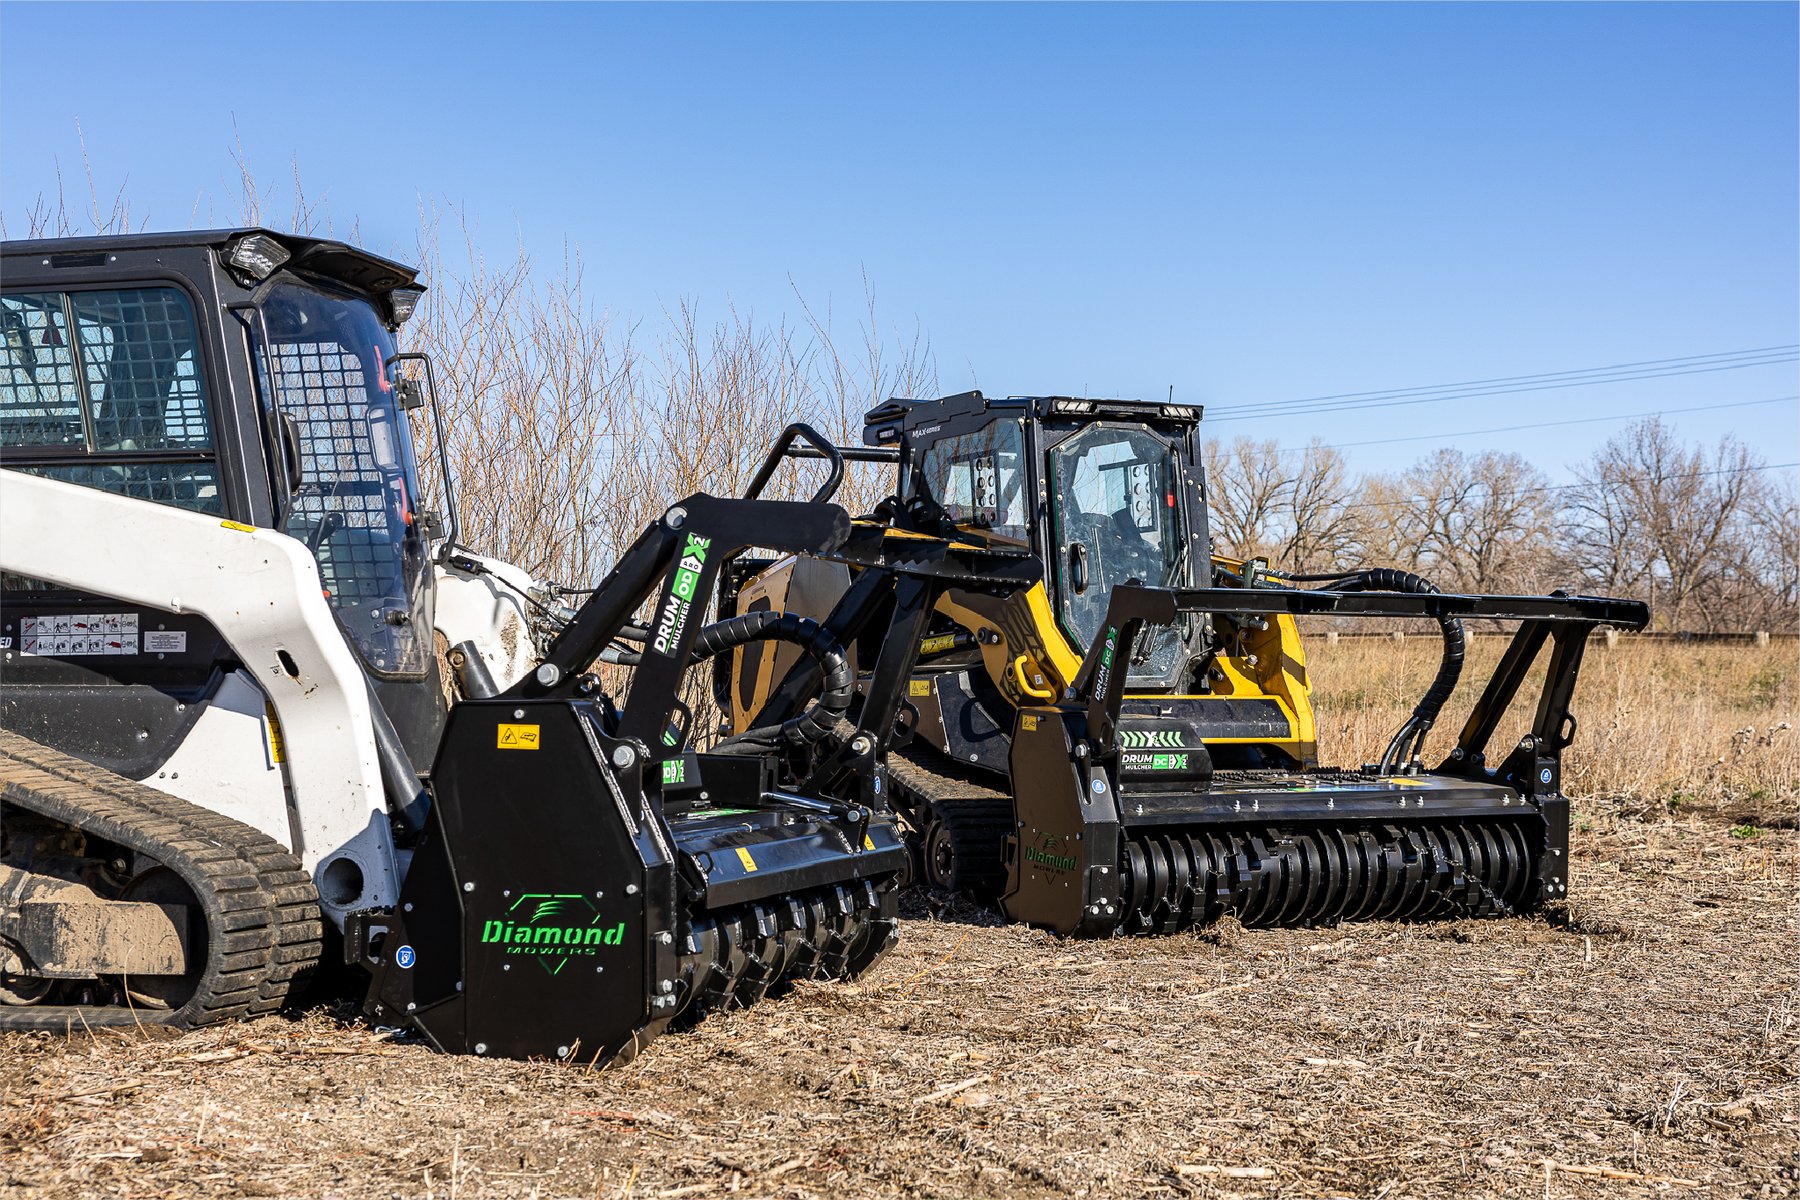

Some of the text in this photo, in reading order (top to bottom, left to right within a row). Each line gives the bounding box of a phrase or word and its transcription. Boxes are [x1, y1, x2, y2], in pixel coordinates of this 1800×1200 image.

[653, 595, 681, 654] DRUM
[679, 572, 693, 596] OD
[670, 602, 691, 650] MULCHER
[1095, 664, 1107, 701] DRUM
[1100, 669, 1110, 700] MULCHER
[1121, 754, 1153, 763] DRUM
[1154, 758, 1168, 766] DC
[1025, 846, 1077, 871] Diamond
[481, 920, 625, 945] Diamond
[507, 947, 596, 956] MOWERS
